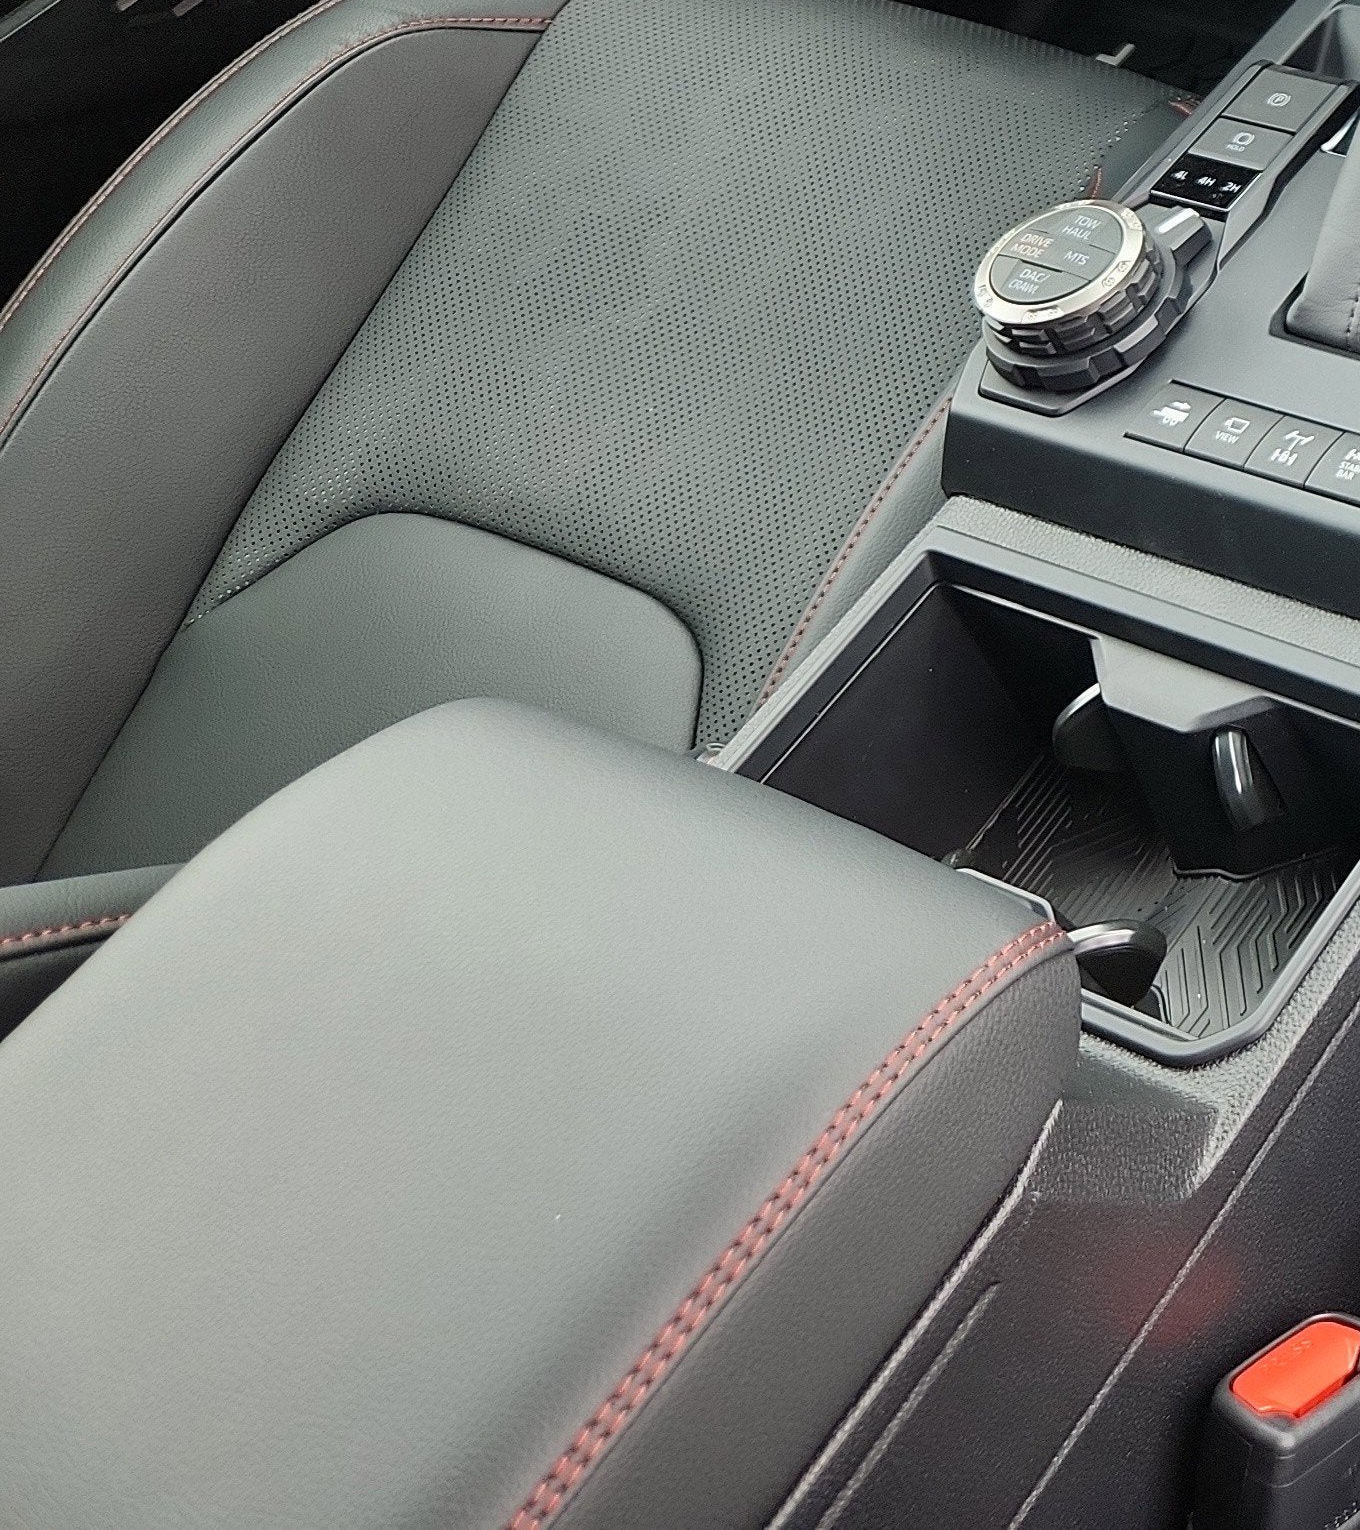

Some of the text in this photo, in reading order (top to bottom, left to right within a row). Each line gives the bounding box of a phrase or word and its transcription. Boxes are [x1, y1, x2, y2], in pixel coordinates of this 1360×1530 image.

[1173, 170, 1189, 180] 4L
[1196, 176, 1216, 186] 4H
[1221, 182, 1242, 192] 2H
[1074, 215, 1100, 229] TOW
[1020, 233, 1054, 247] DRIVE
[1061, 226, 1092, 240] HAUL
[1011, 243, 1045, 258] MODE
[1063, 251, 1090, 265] MTS
[1019, 268, 1051, 283] DAC/
[1215, 430, 1239, 444] VIEW
[1335, 470, 1356, 481] BAR
